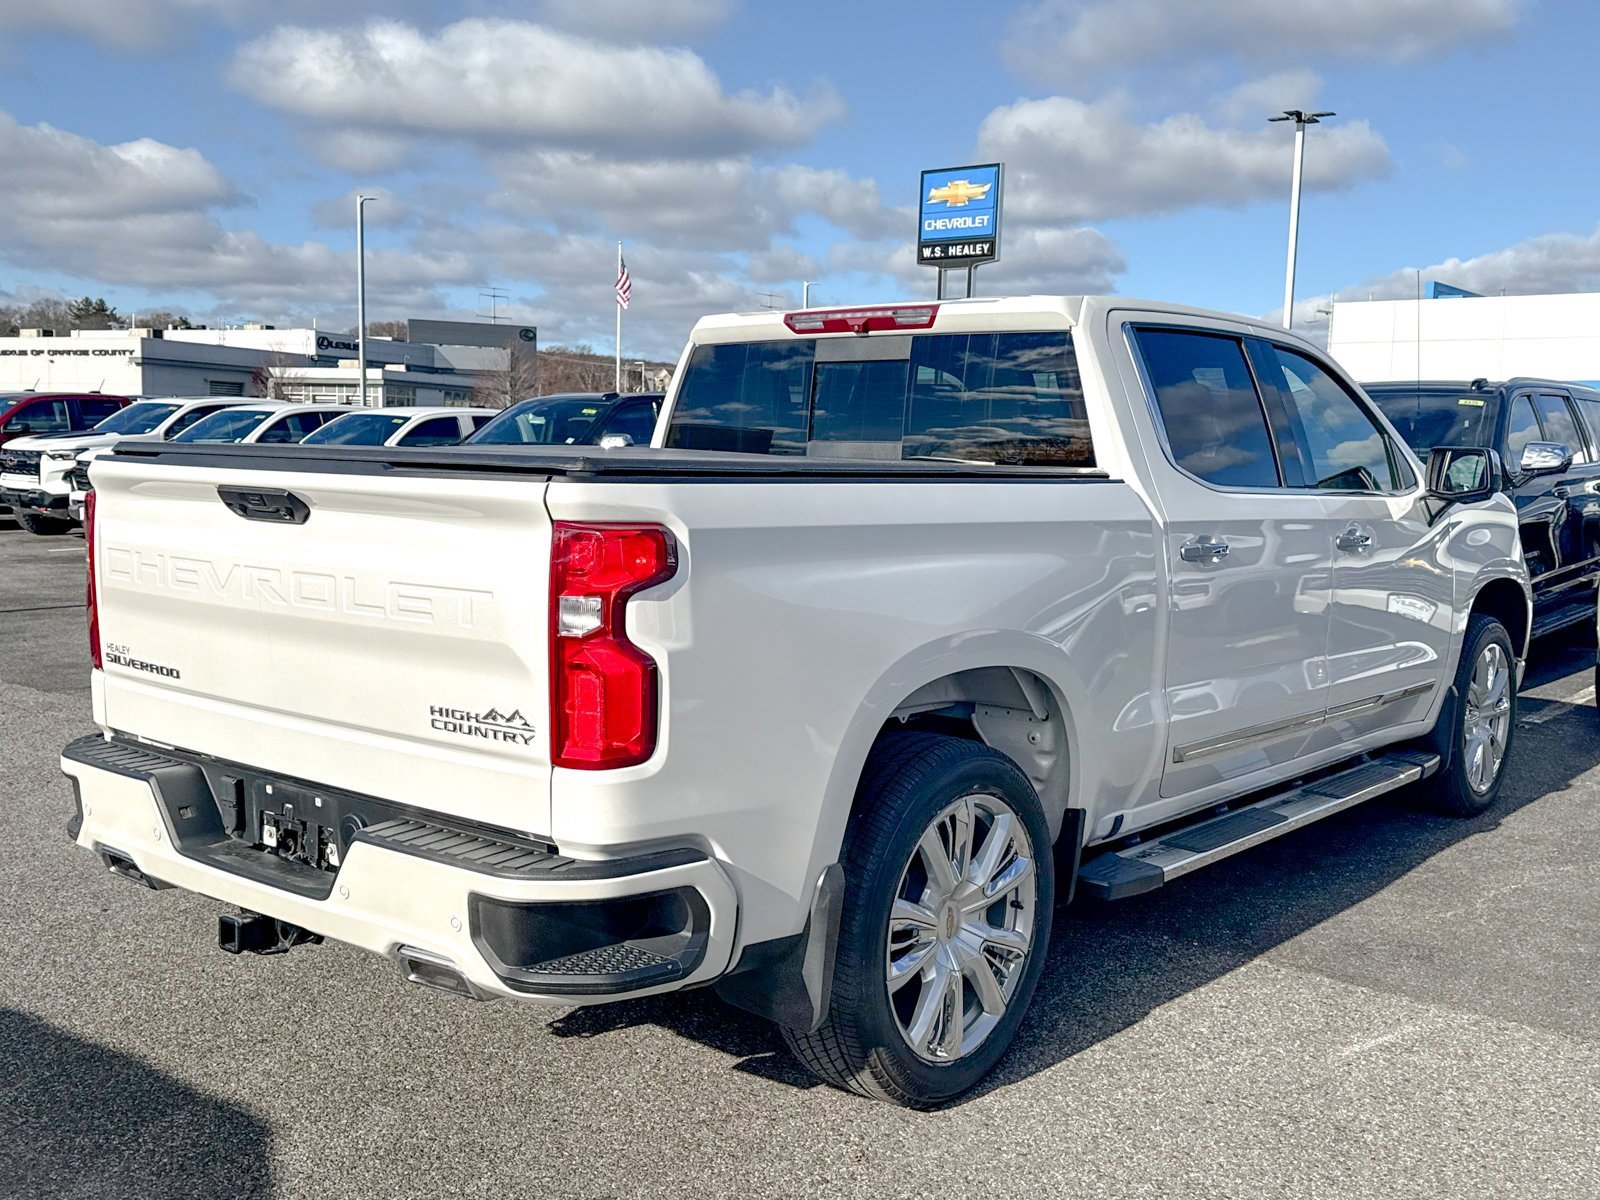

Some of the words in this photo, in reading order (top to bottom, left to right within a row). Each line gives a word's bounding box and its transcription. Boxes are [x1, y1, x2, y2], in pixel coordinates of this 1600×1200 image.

[924, 215, 989, 231] CHEVROLET
[922, 247, 945, 258] W.S.
[948, 243, 990, 256] HEALEY
[105, 547, 494, 629] CHEVROLET
[106, 642, 130, 655] HEALEY
[105, 652, 181, 679] SILVERADO
[430, 705, 481, 723] HIGH
[431, 718, 536, 745] COUNTRY
